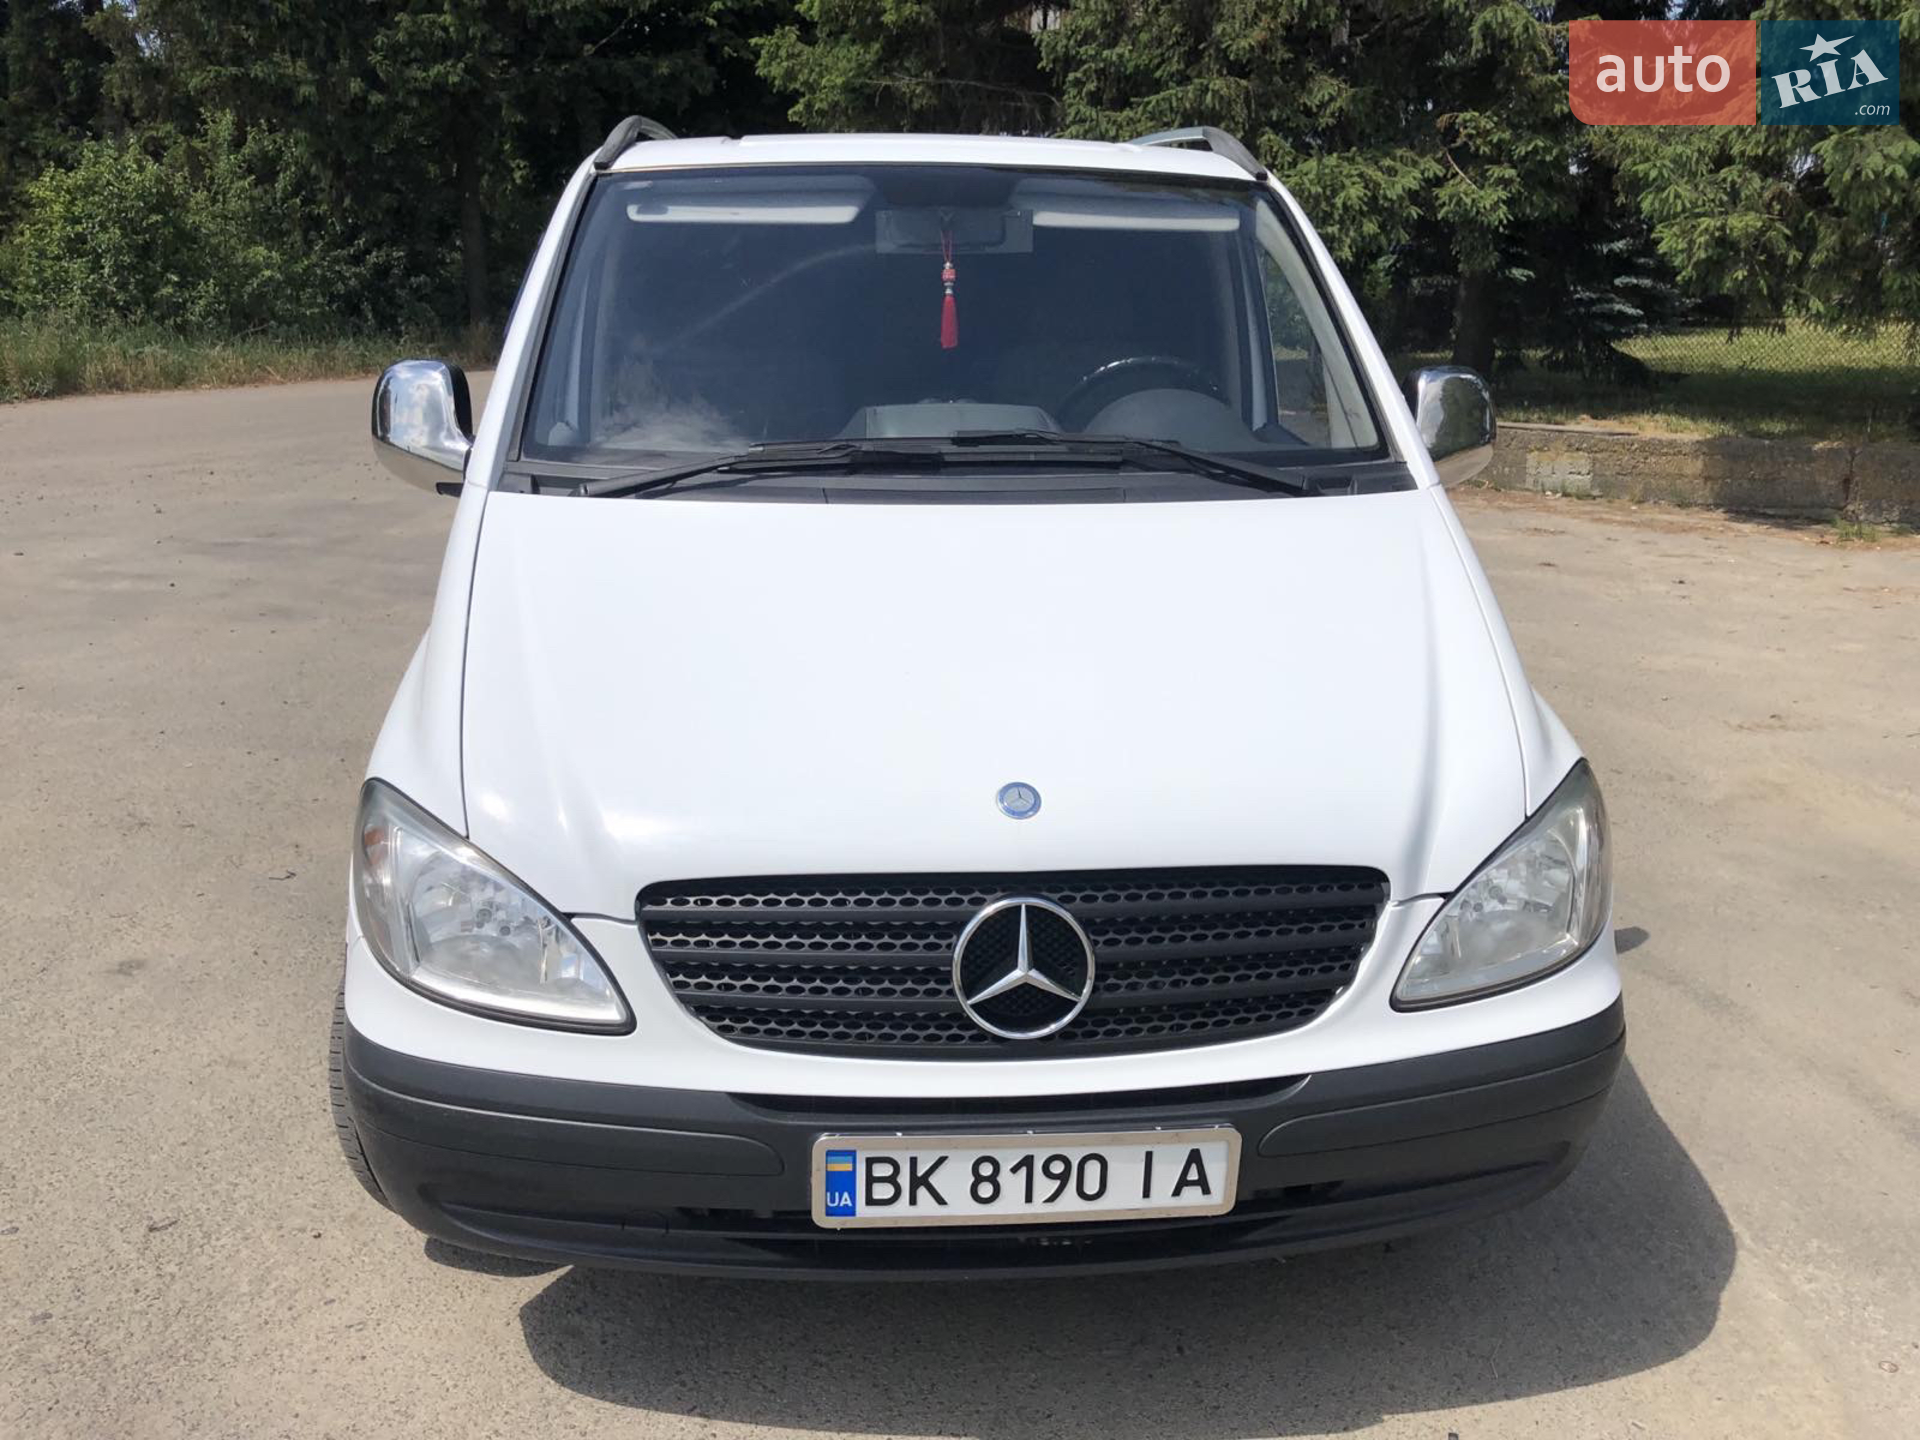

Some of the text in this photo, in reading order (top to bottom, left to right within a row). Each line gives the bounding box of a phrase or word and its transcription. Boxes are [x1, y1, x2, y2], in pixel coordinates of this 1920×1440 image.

[864, 1155, 949, 1207] BK
[969, 1152, 1109, 1205] 8190
[826, 1192, 853, 1208] UA
